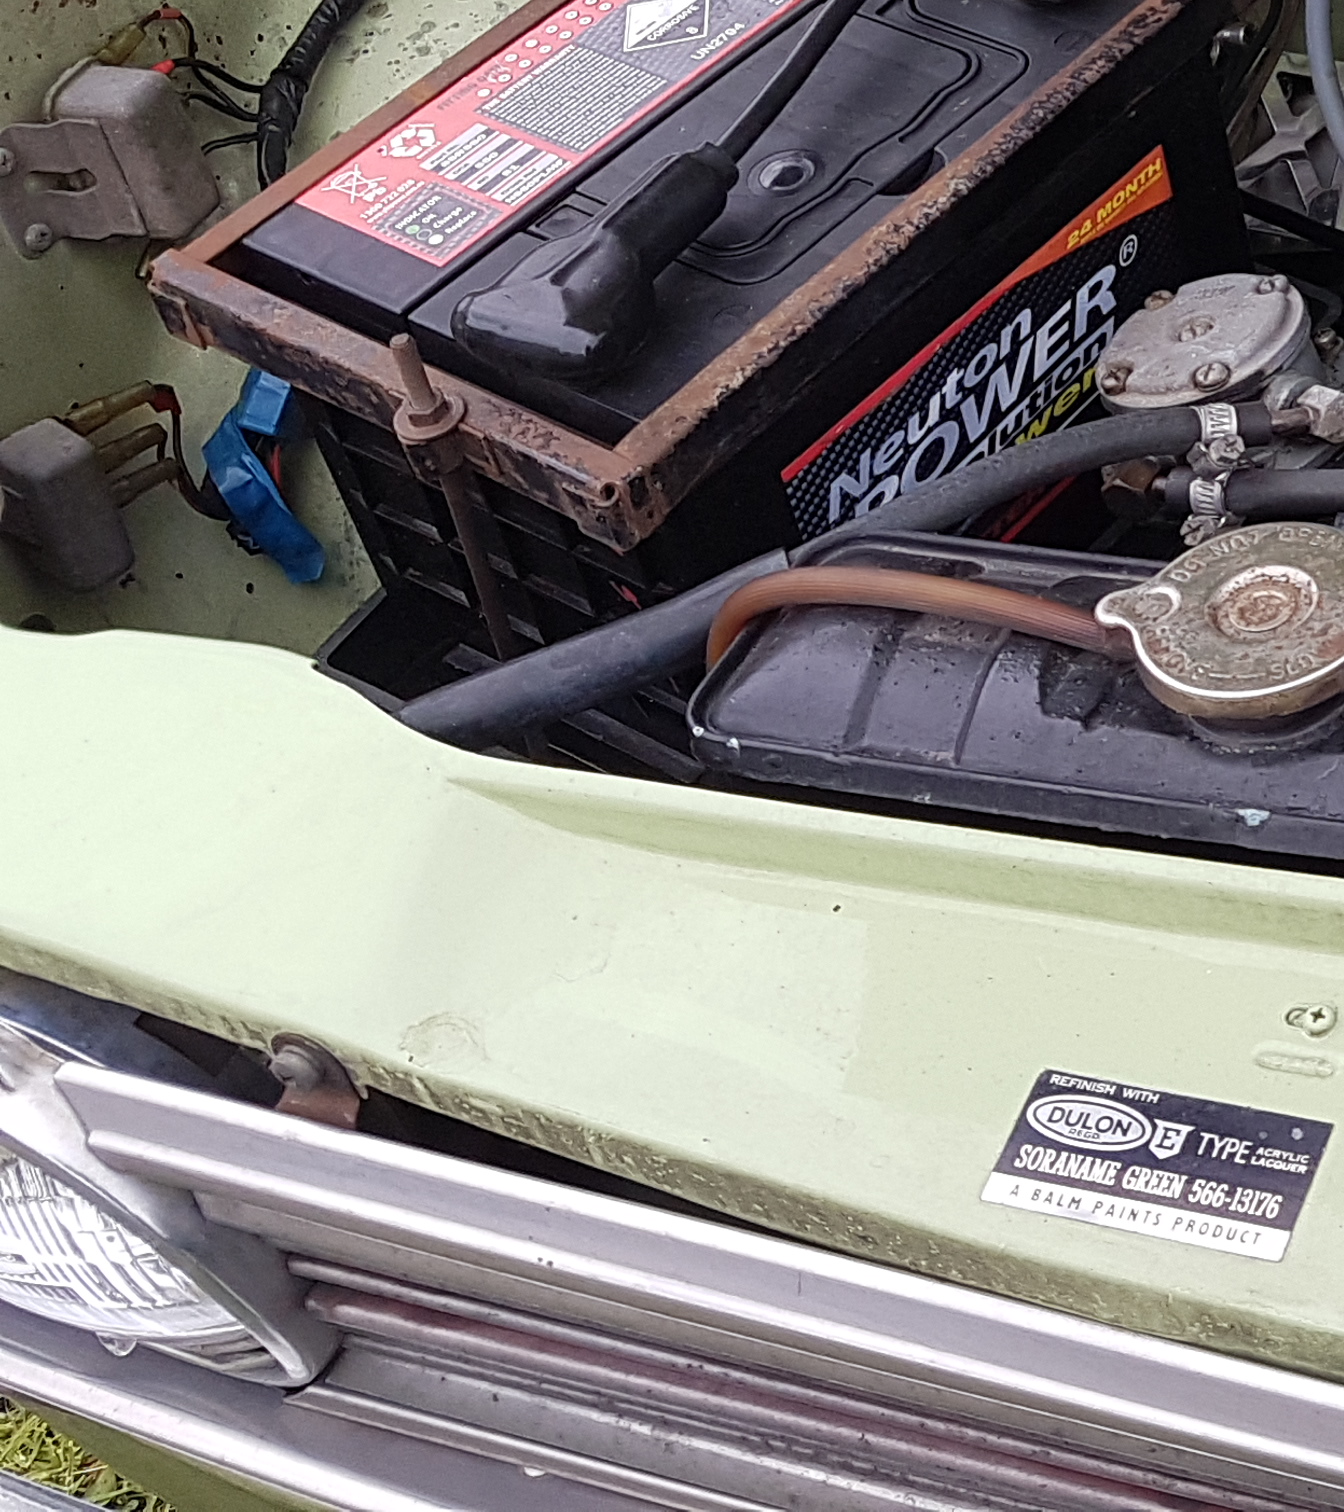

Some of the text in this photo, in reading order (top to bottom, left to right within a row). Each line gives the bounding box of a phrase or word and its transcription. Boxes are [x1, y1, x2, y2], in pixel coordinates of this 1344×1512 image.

[431, 203, 464, 231] Charge
[1062, 217, 1093, 249] 24
[1093, 157, 1164, 223] MONTH
[828, 307, 1032, 524] Neuton
[1049, 1073, 1160, 1104] REFINISH WITH
[1047, 1106, 1133, 1137] DULON
[1155, 1127, 1254, 1165] E TYPE
[1255, 1146, 1309, 1164] ACRYLIC
[1013, 1145, 1283, 1219] SORANAME GREEN 566-13176
[1250, 1159, 1308, 1175] LACQUER
[1010, 1185, 1262, 1245] A BALM PAINTS PRODUCT
